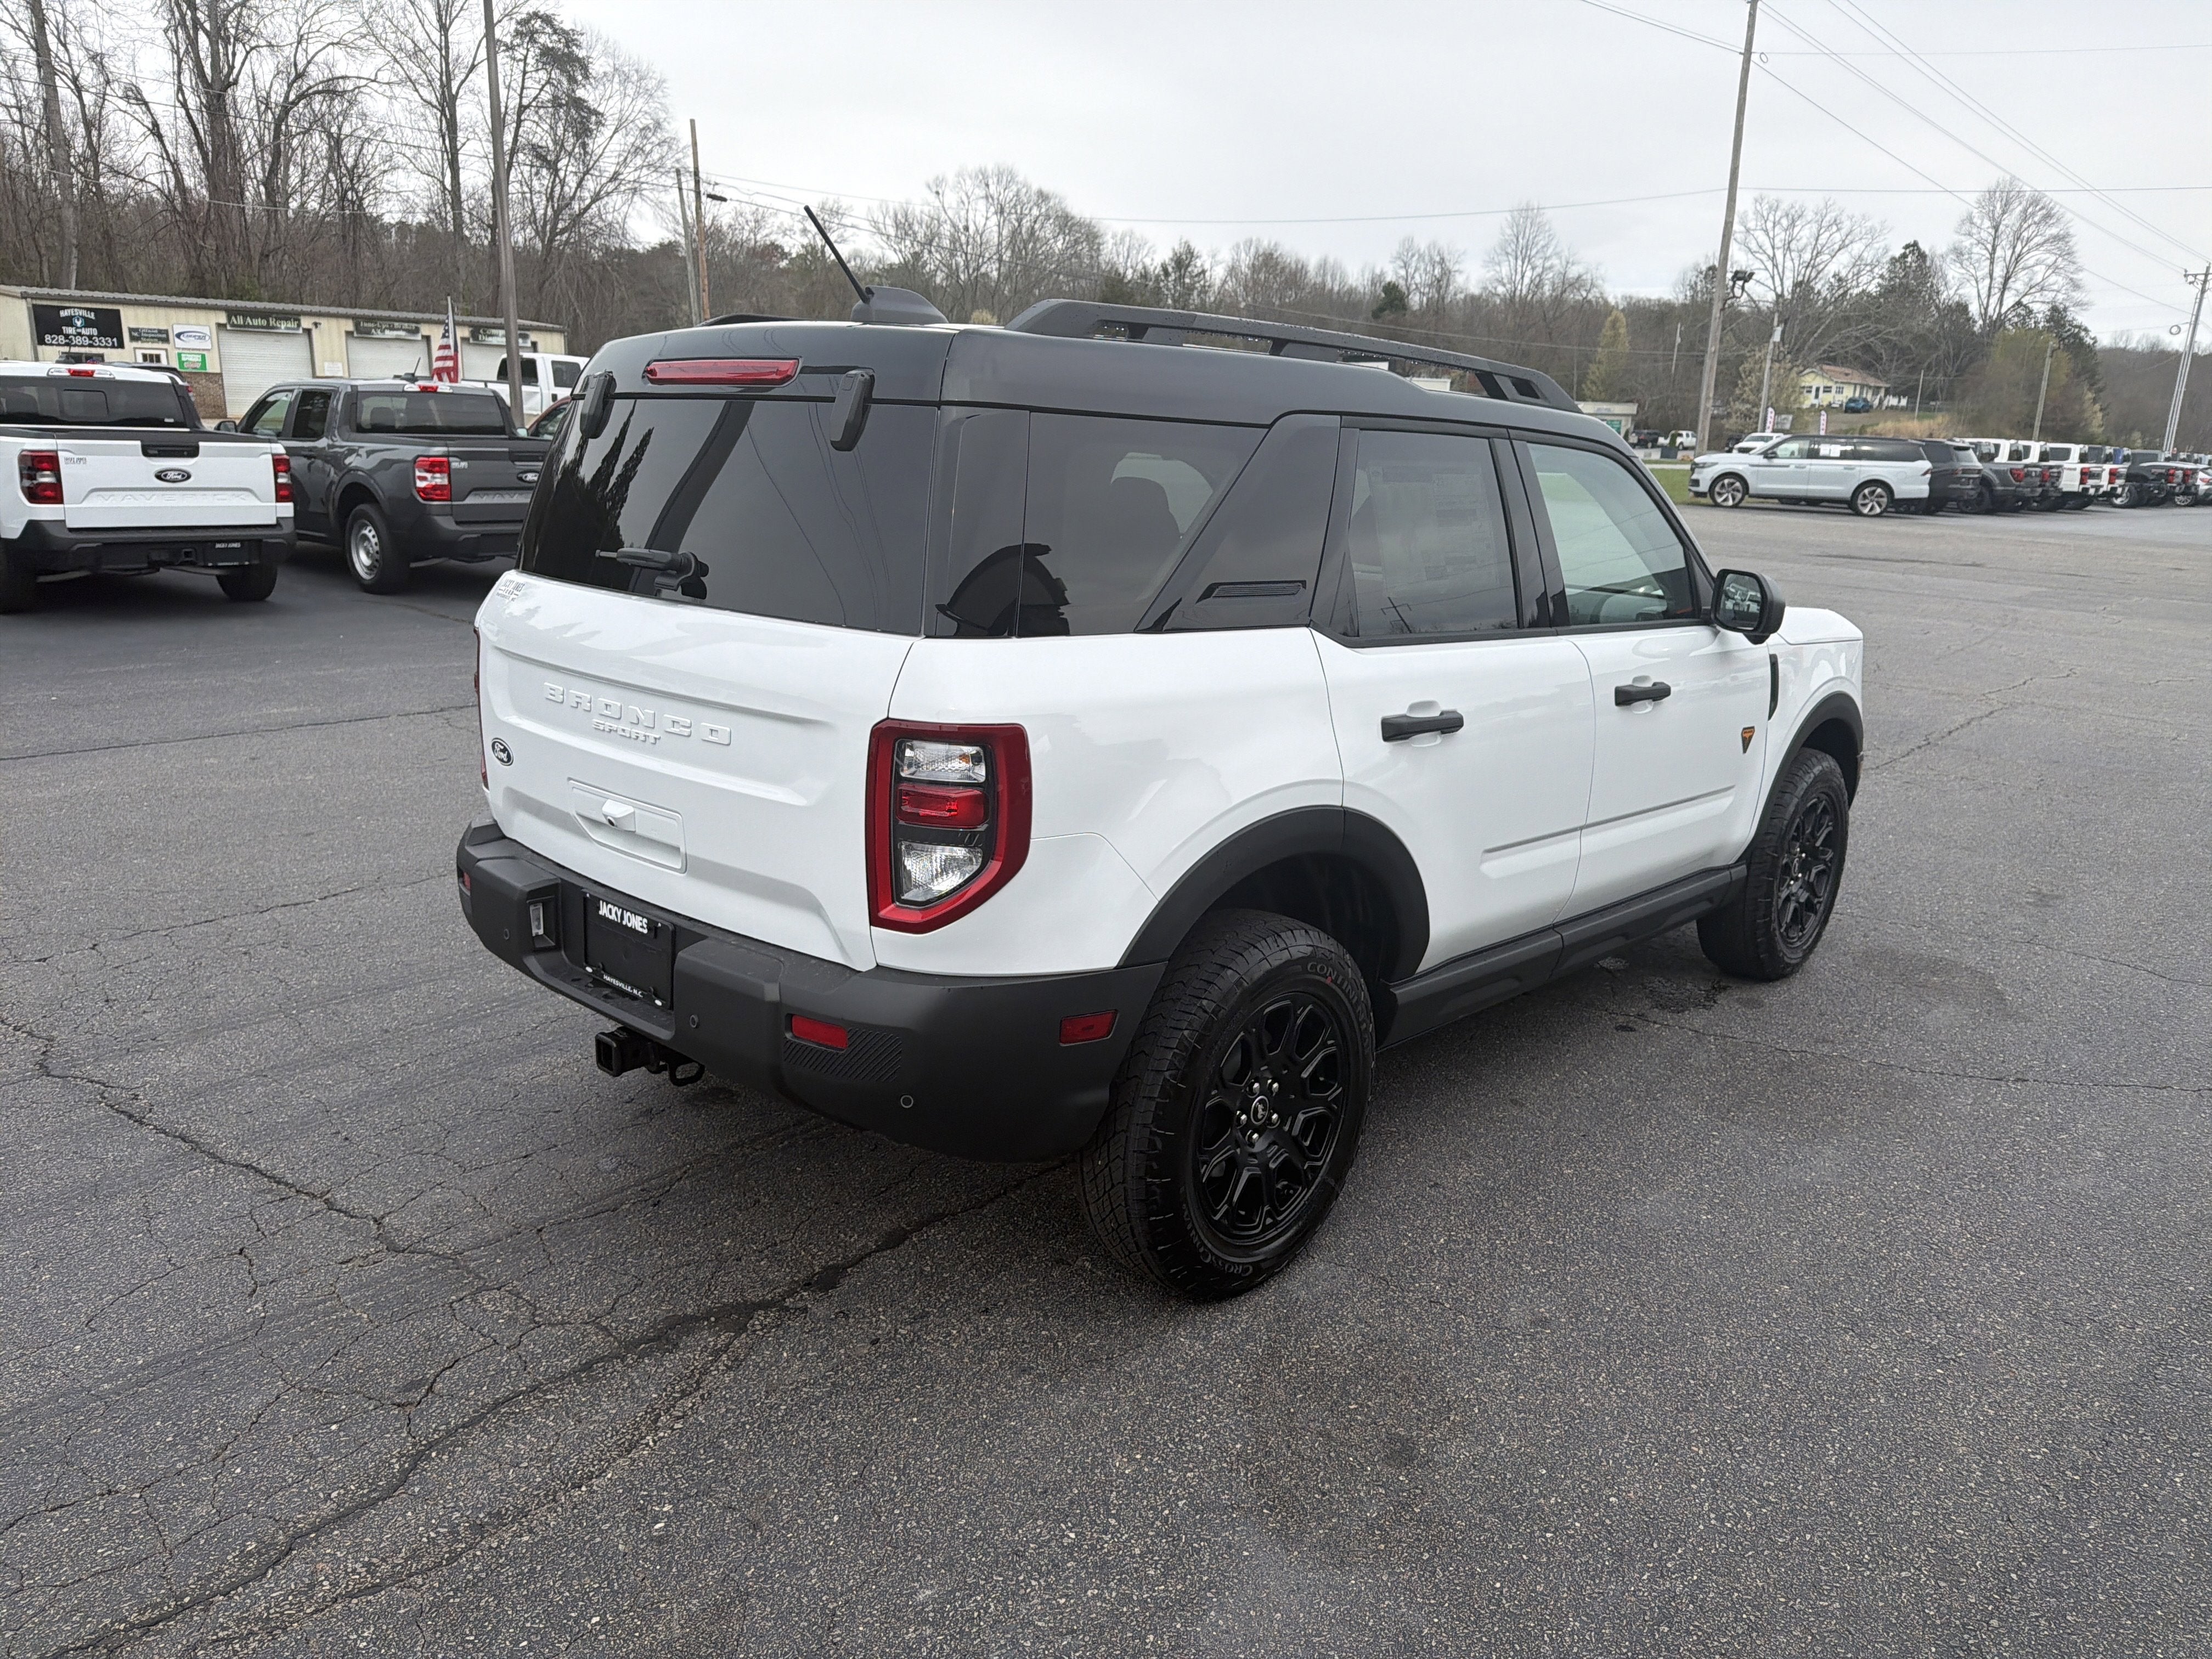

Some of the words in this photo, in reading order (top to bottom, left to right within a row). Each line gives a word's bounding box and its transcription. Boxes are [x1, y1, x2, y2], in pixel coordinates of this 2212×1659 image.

[60, 308, 95, 319] HAYESVILLE
[230, 315, 244, 325] All
[245, 316, 267, 326] Auto
[269, 317, 298, 329] Repair
[82, 327, 98, 336] AUTO
[44, 334, 117, 347] 828-389-3331
[544, 682, 731, 746] BRONCO
[592, 719, 661, 744] SPORT
[494, 742, 509, 762] Ford
[599, 900, 622, 923] JACKY
[622, 910, 648, 934] JONES
